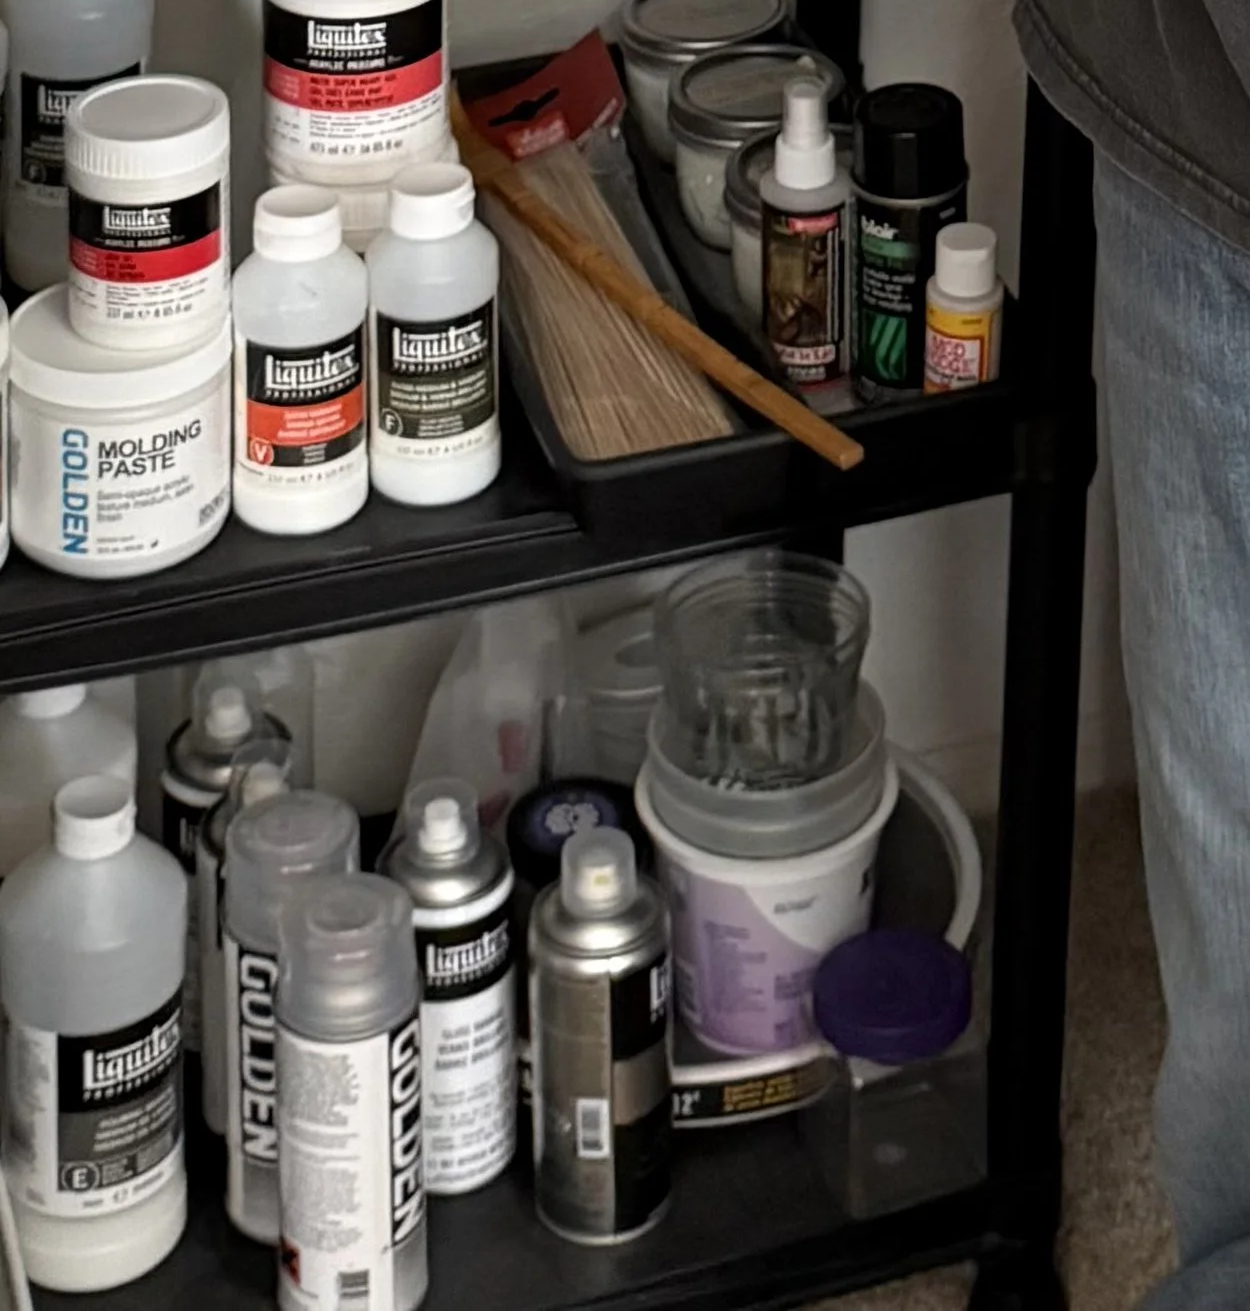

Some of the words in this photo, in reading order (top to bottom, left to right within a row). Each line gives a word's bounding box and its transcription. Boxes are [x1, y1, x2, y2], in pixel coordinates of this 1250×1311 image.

[307, 19, 387, 51] Liquitex
[103, 205, 172, 230] Liquitex
[393, 319, 488, 362] Liquitex
[264, 343, 360, 390] Liquitex
[97, 419, 202, 460] MOLDING
[97, 449, 176, 479] PASTE
[62, 428, 89, 555] GOLDEN
[240, 952, 279, 1167] GOLDEN
